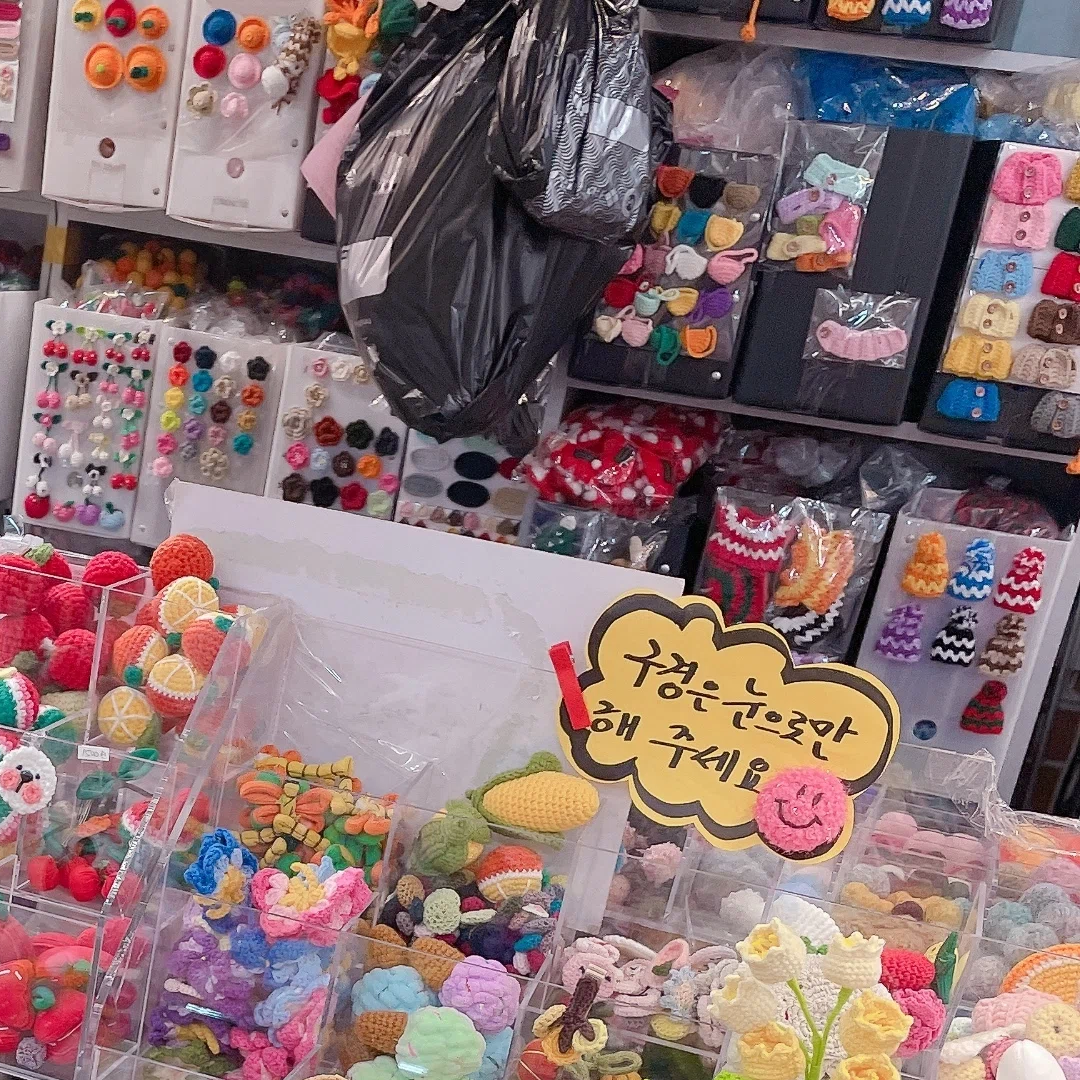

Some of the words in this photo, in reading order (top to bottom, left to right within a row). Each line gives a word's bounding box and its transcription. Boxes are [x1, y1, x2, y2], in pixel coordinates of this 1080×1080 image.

[590, 700, 641, 742] 해
[648, 725, 771, 795] 주세요
[623, 638, 720, 713] 구경은
[721, 677, 859, 761] 눈으로만
